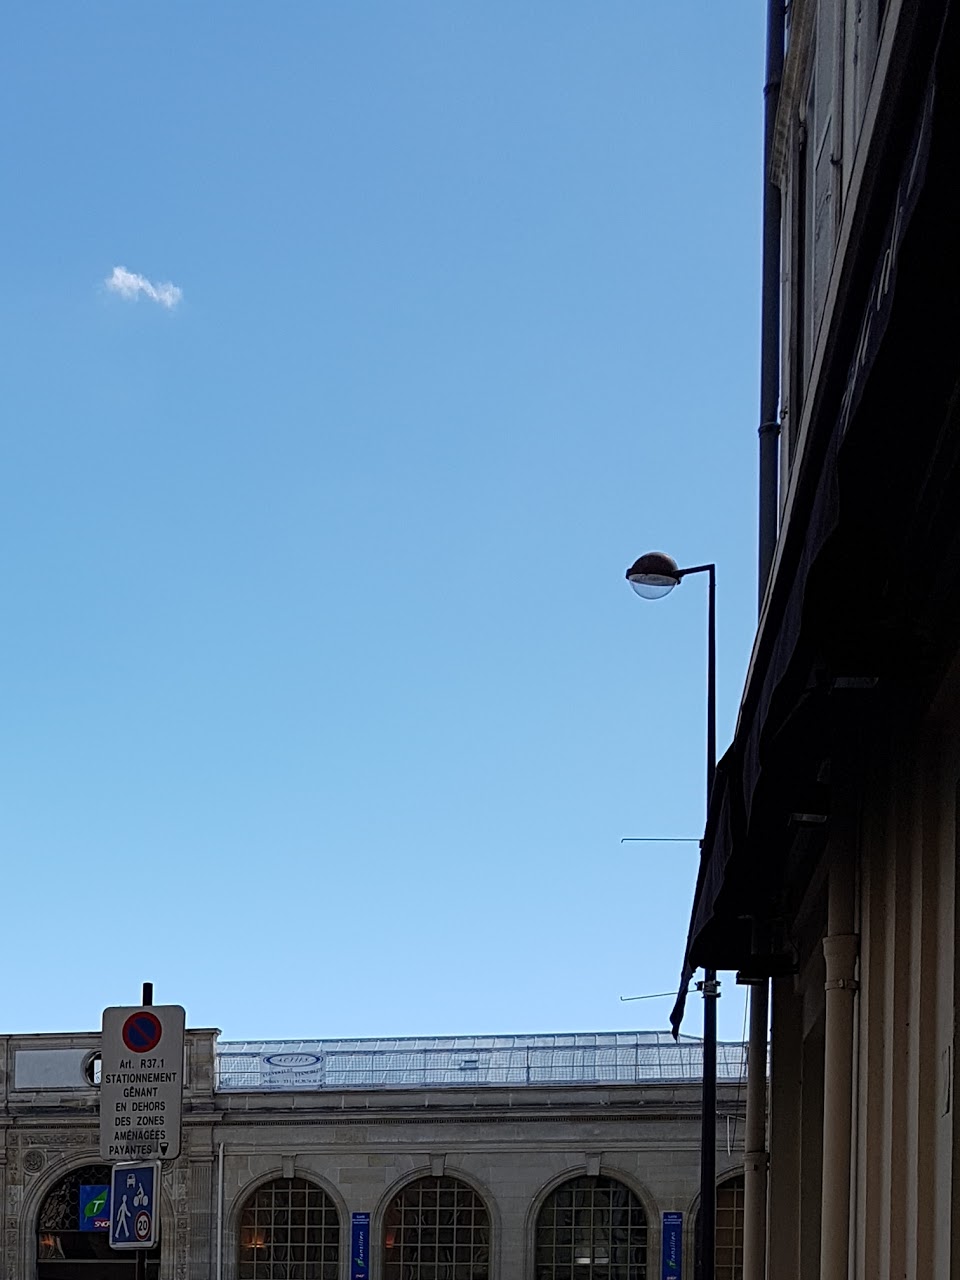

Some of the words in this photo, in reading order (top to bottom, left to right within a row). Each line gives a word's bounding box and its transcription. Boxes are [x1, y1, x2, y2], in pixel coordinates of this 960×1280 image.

[119, 1059, 134, 1069] Art.
[140, 1058, 164, 1068] R37.1
[105, 1072, 177, 1084] STATIONNEMENT
[123, 1086, 158, 1098] GÊNANT
[115, 1102, 126, 1112] EN
[132, 1101, 166, 1111] DEHORS
[114, 1116, 131, 1126] DES
[136, 1115, 165, 1126] ZONES
[114, 1129, 166, 1141] AMÉNAGÉES
[109, 1144, 152, 1155] PAYANTES
[138, 1220, 147, 1231] 20
